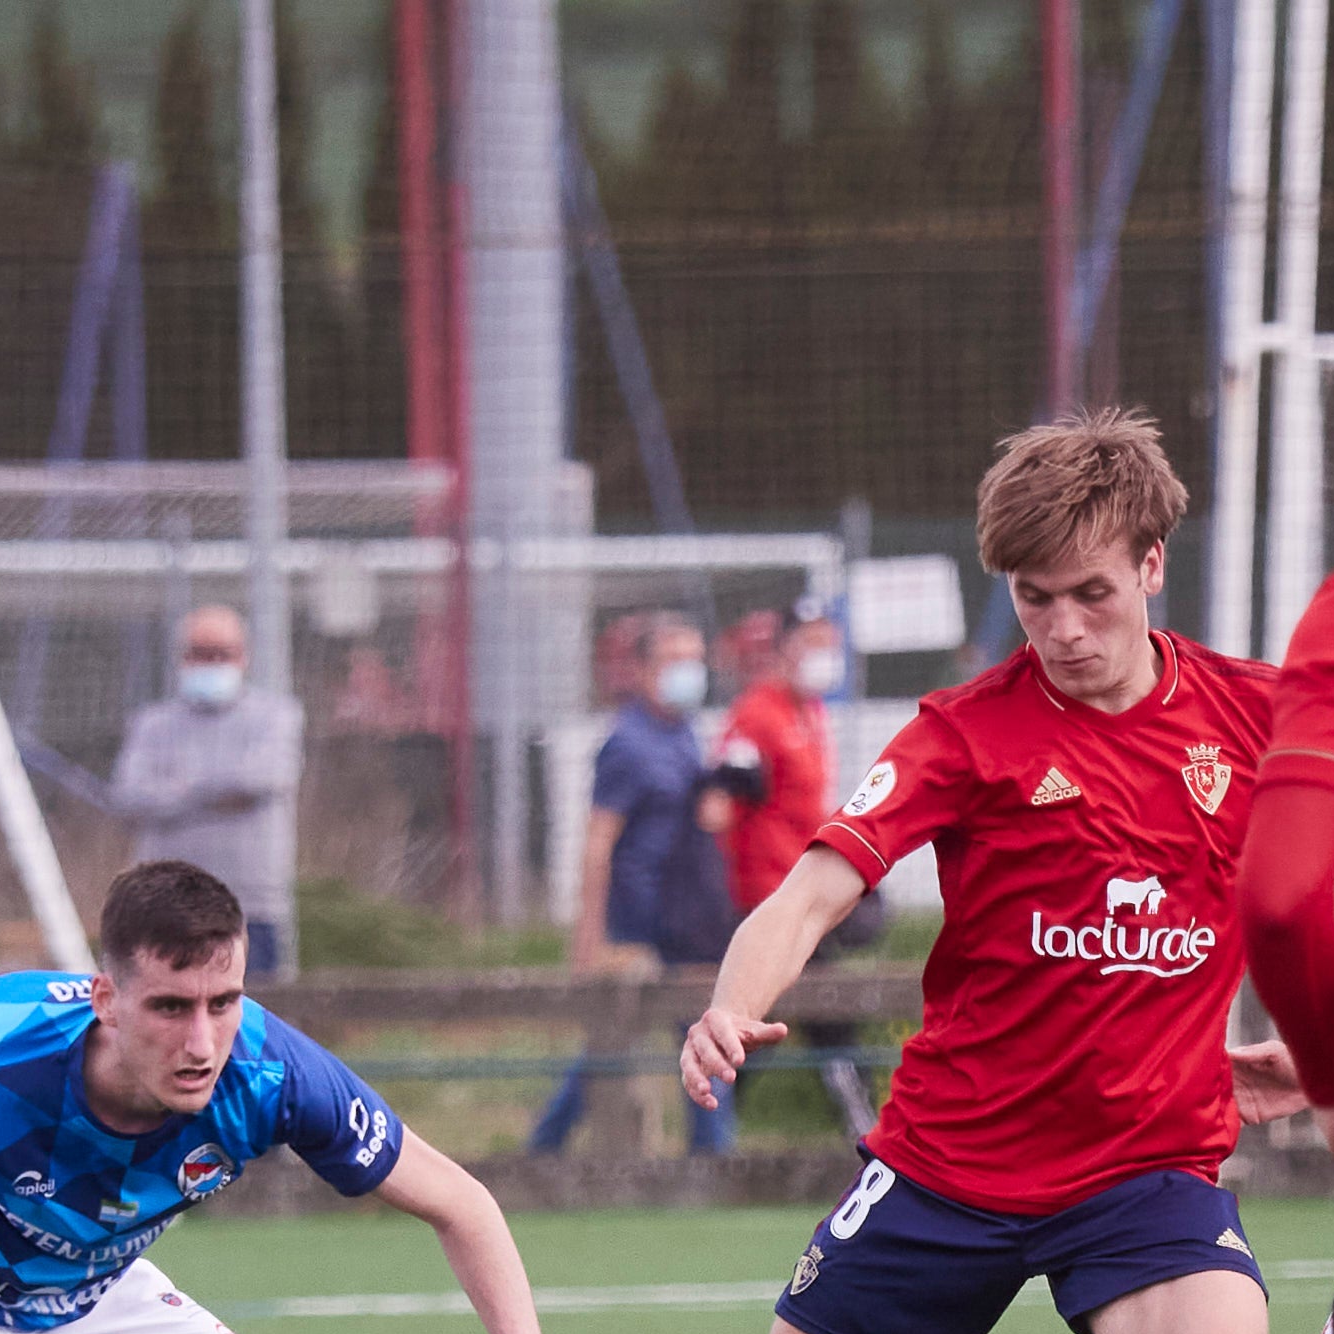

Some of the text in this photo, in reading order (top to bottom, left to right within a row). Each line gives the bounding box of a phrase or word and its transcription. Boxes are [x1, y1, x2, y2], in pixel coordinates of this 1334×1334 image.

[1031, 785, 1082, 806] adidas
[355, 1108, 388, 1168] Beco
[829, 1158, 897, 1241] 8
